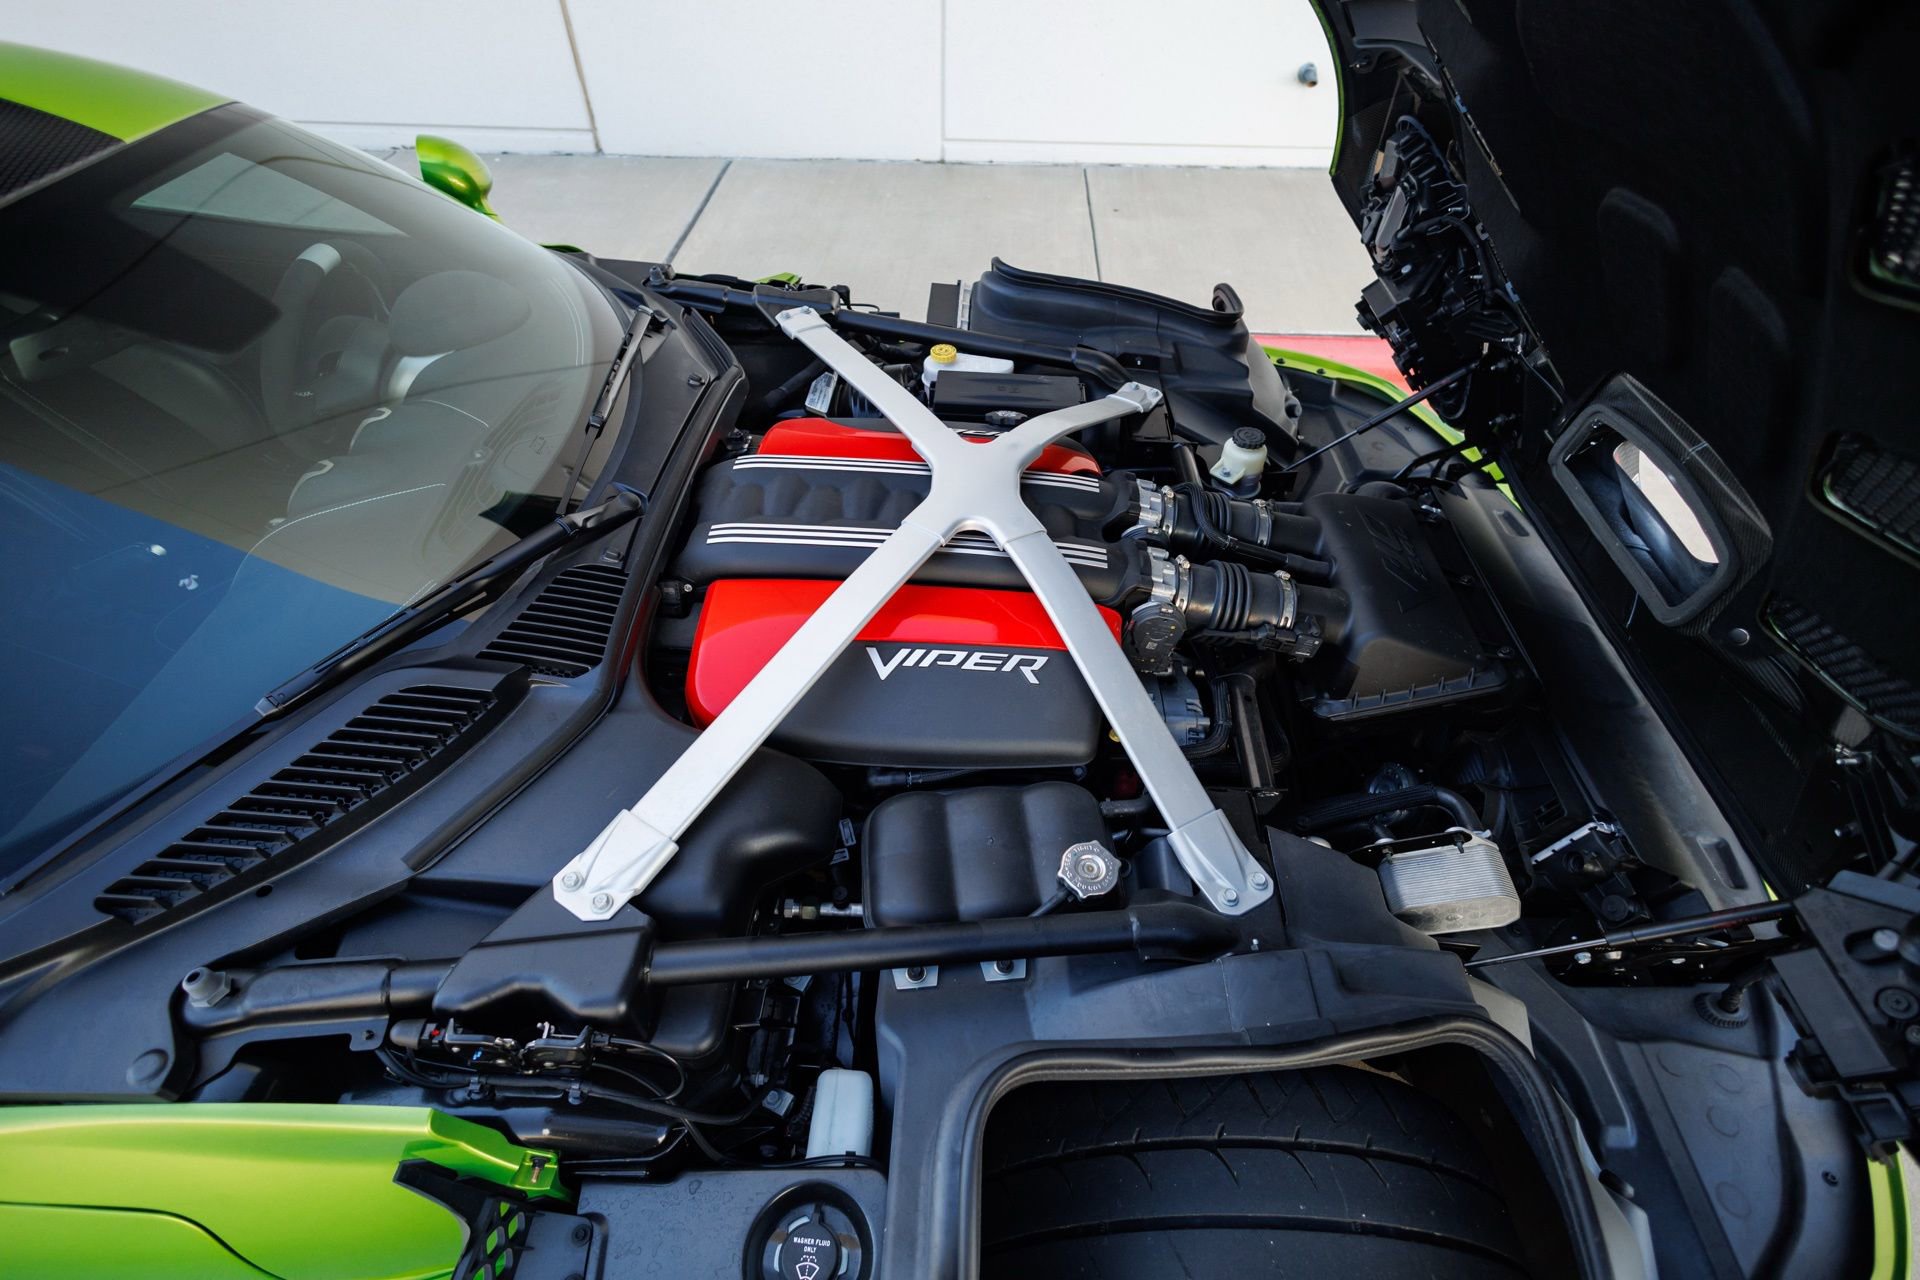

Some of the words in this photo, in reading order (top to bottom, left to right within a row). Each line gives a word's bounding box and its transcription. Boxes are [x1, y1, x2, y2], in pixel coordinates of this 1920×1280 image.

[866, 647, 1049, 684] VIPER
[793, 1237, 815, 1245] WASHER
[815, 1239, 831, 1247] FLUID
